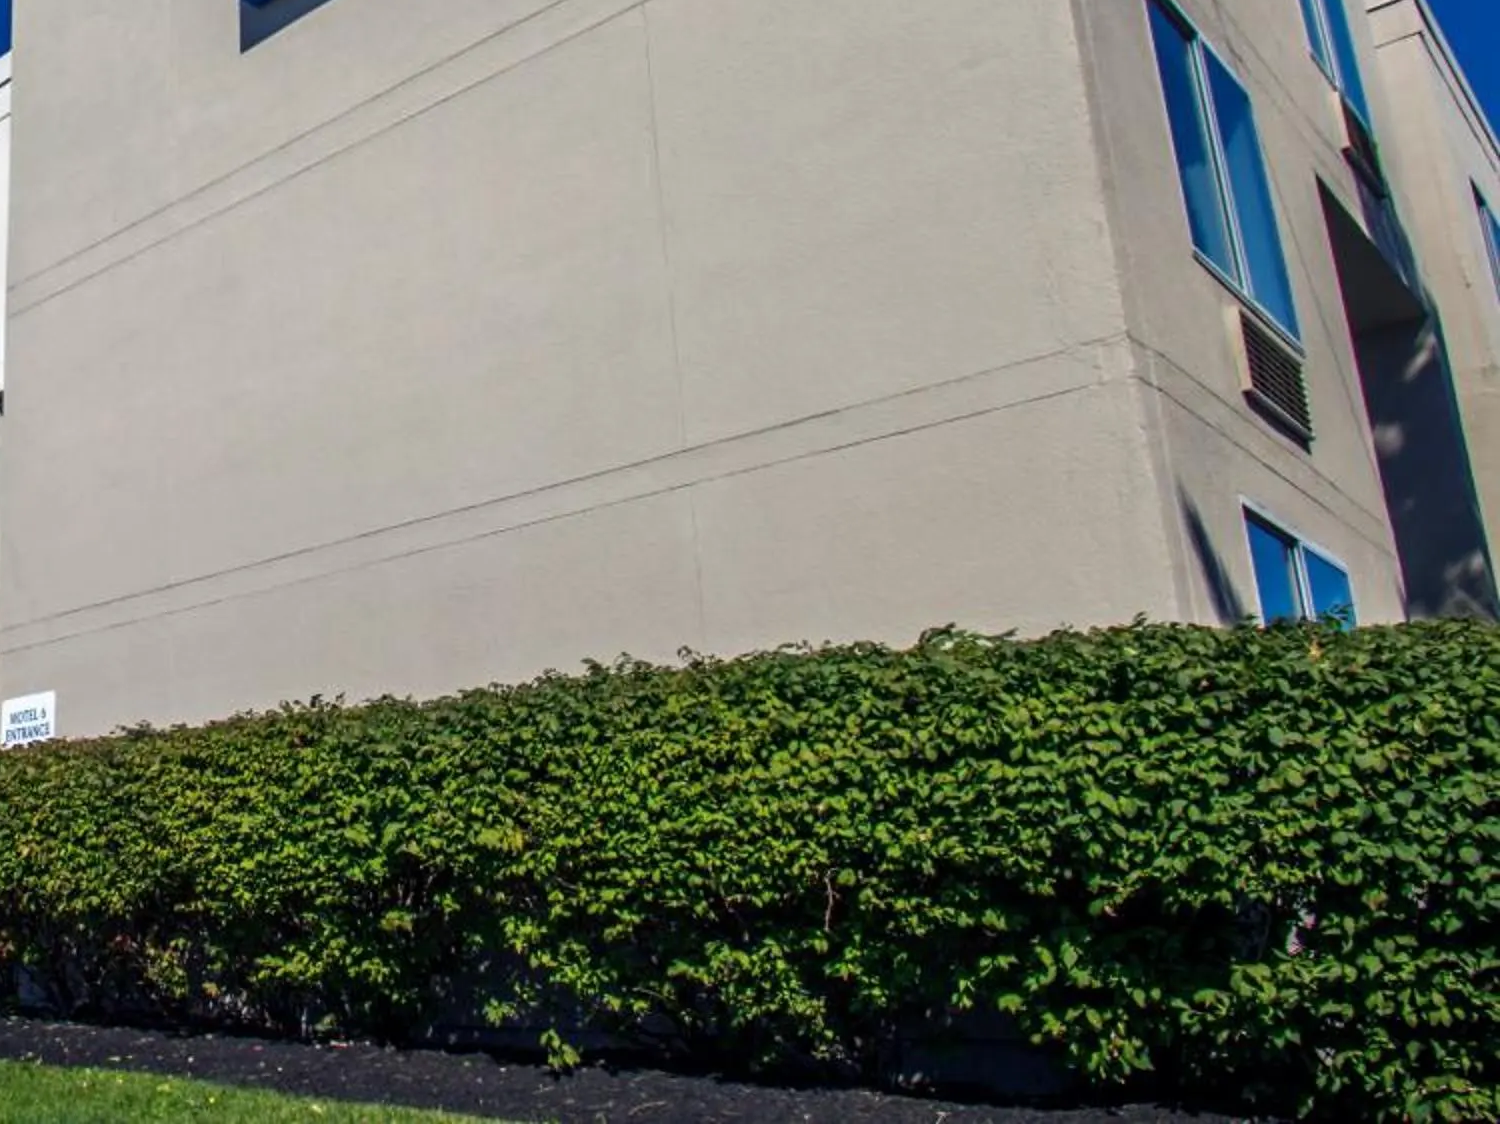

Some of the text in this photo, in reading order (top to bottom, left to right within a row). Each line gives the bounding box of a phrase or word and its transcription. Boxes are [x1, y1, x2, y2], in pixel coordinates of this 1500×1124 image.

[9, 707, 47, 724] MOTEL 6
[5, 722, 50, 742] ENTRANCE
